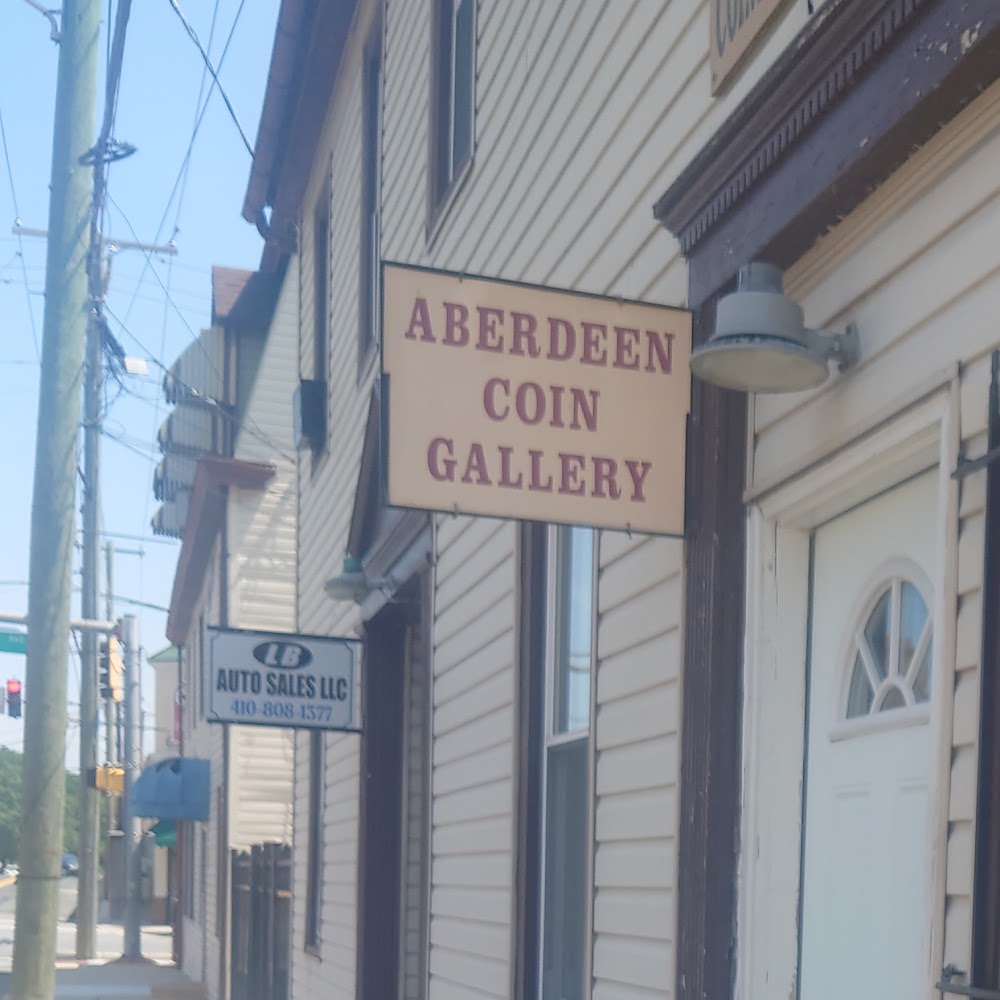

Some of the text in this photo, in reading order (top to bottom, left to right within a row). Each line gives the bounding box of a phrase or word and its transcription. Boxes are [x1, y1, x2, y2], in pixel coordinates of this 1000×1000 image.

[404, 297, 675, 375] ABERDEEN
[483, 377, 601, 432] COIN
[427, 437, 652, 502] GALLERY
[265, 642, 304, 667] LB
[216, 669, 348, 701] AUTO SALES LLC
